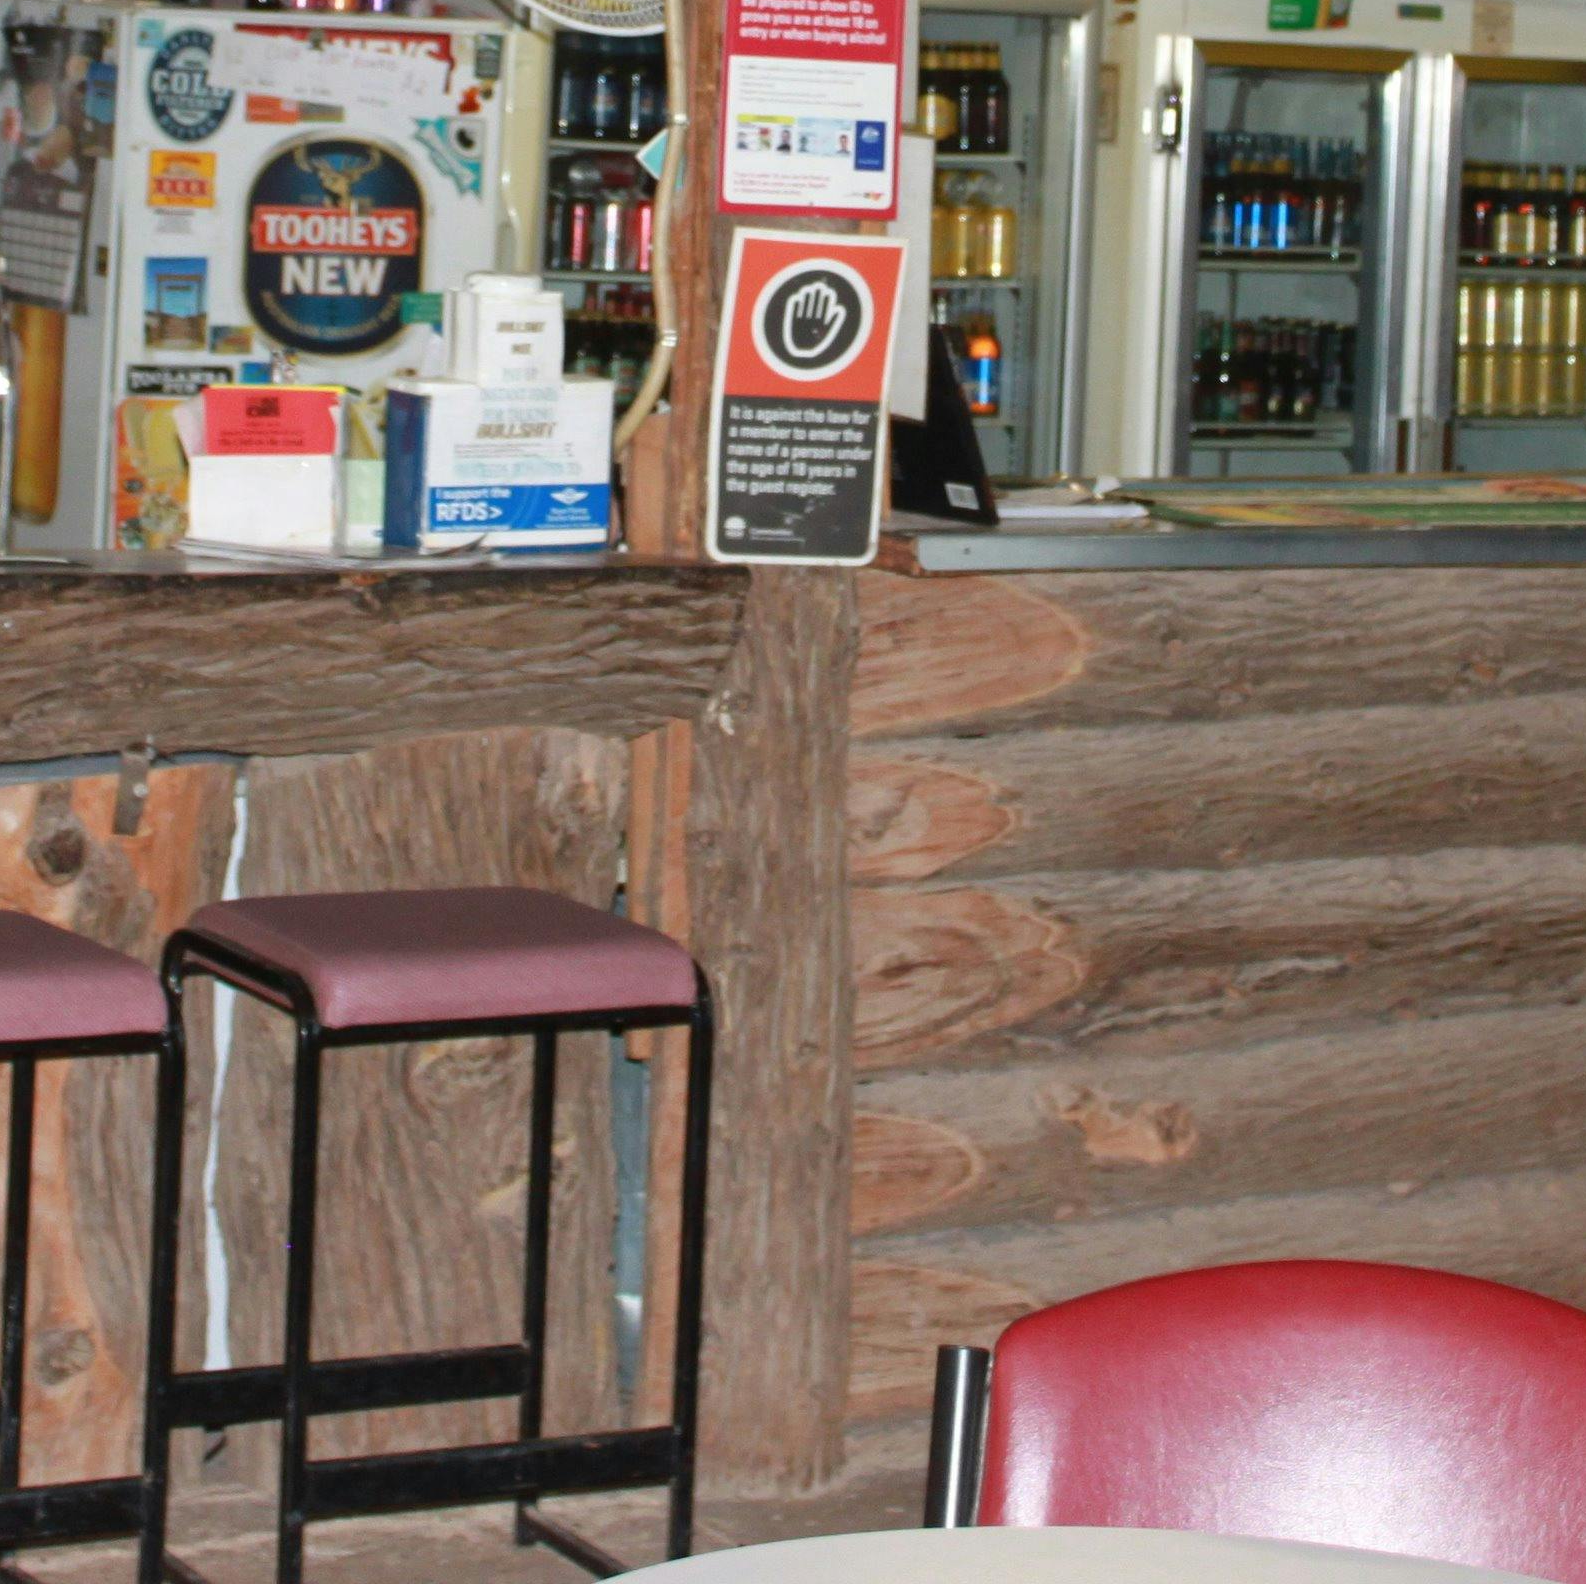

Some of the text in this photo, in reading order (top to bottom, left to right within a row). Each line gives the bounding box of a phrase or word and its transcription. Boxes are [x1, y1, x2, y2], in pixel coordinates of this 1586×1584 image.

[264, 213, 408, 249] TOOHEYS
[280, 257, 389, 297] NEW
[755, 408, 802, 424] against
